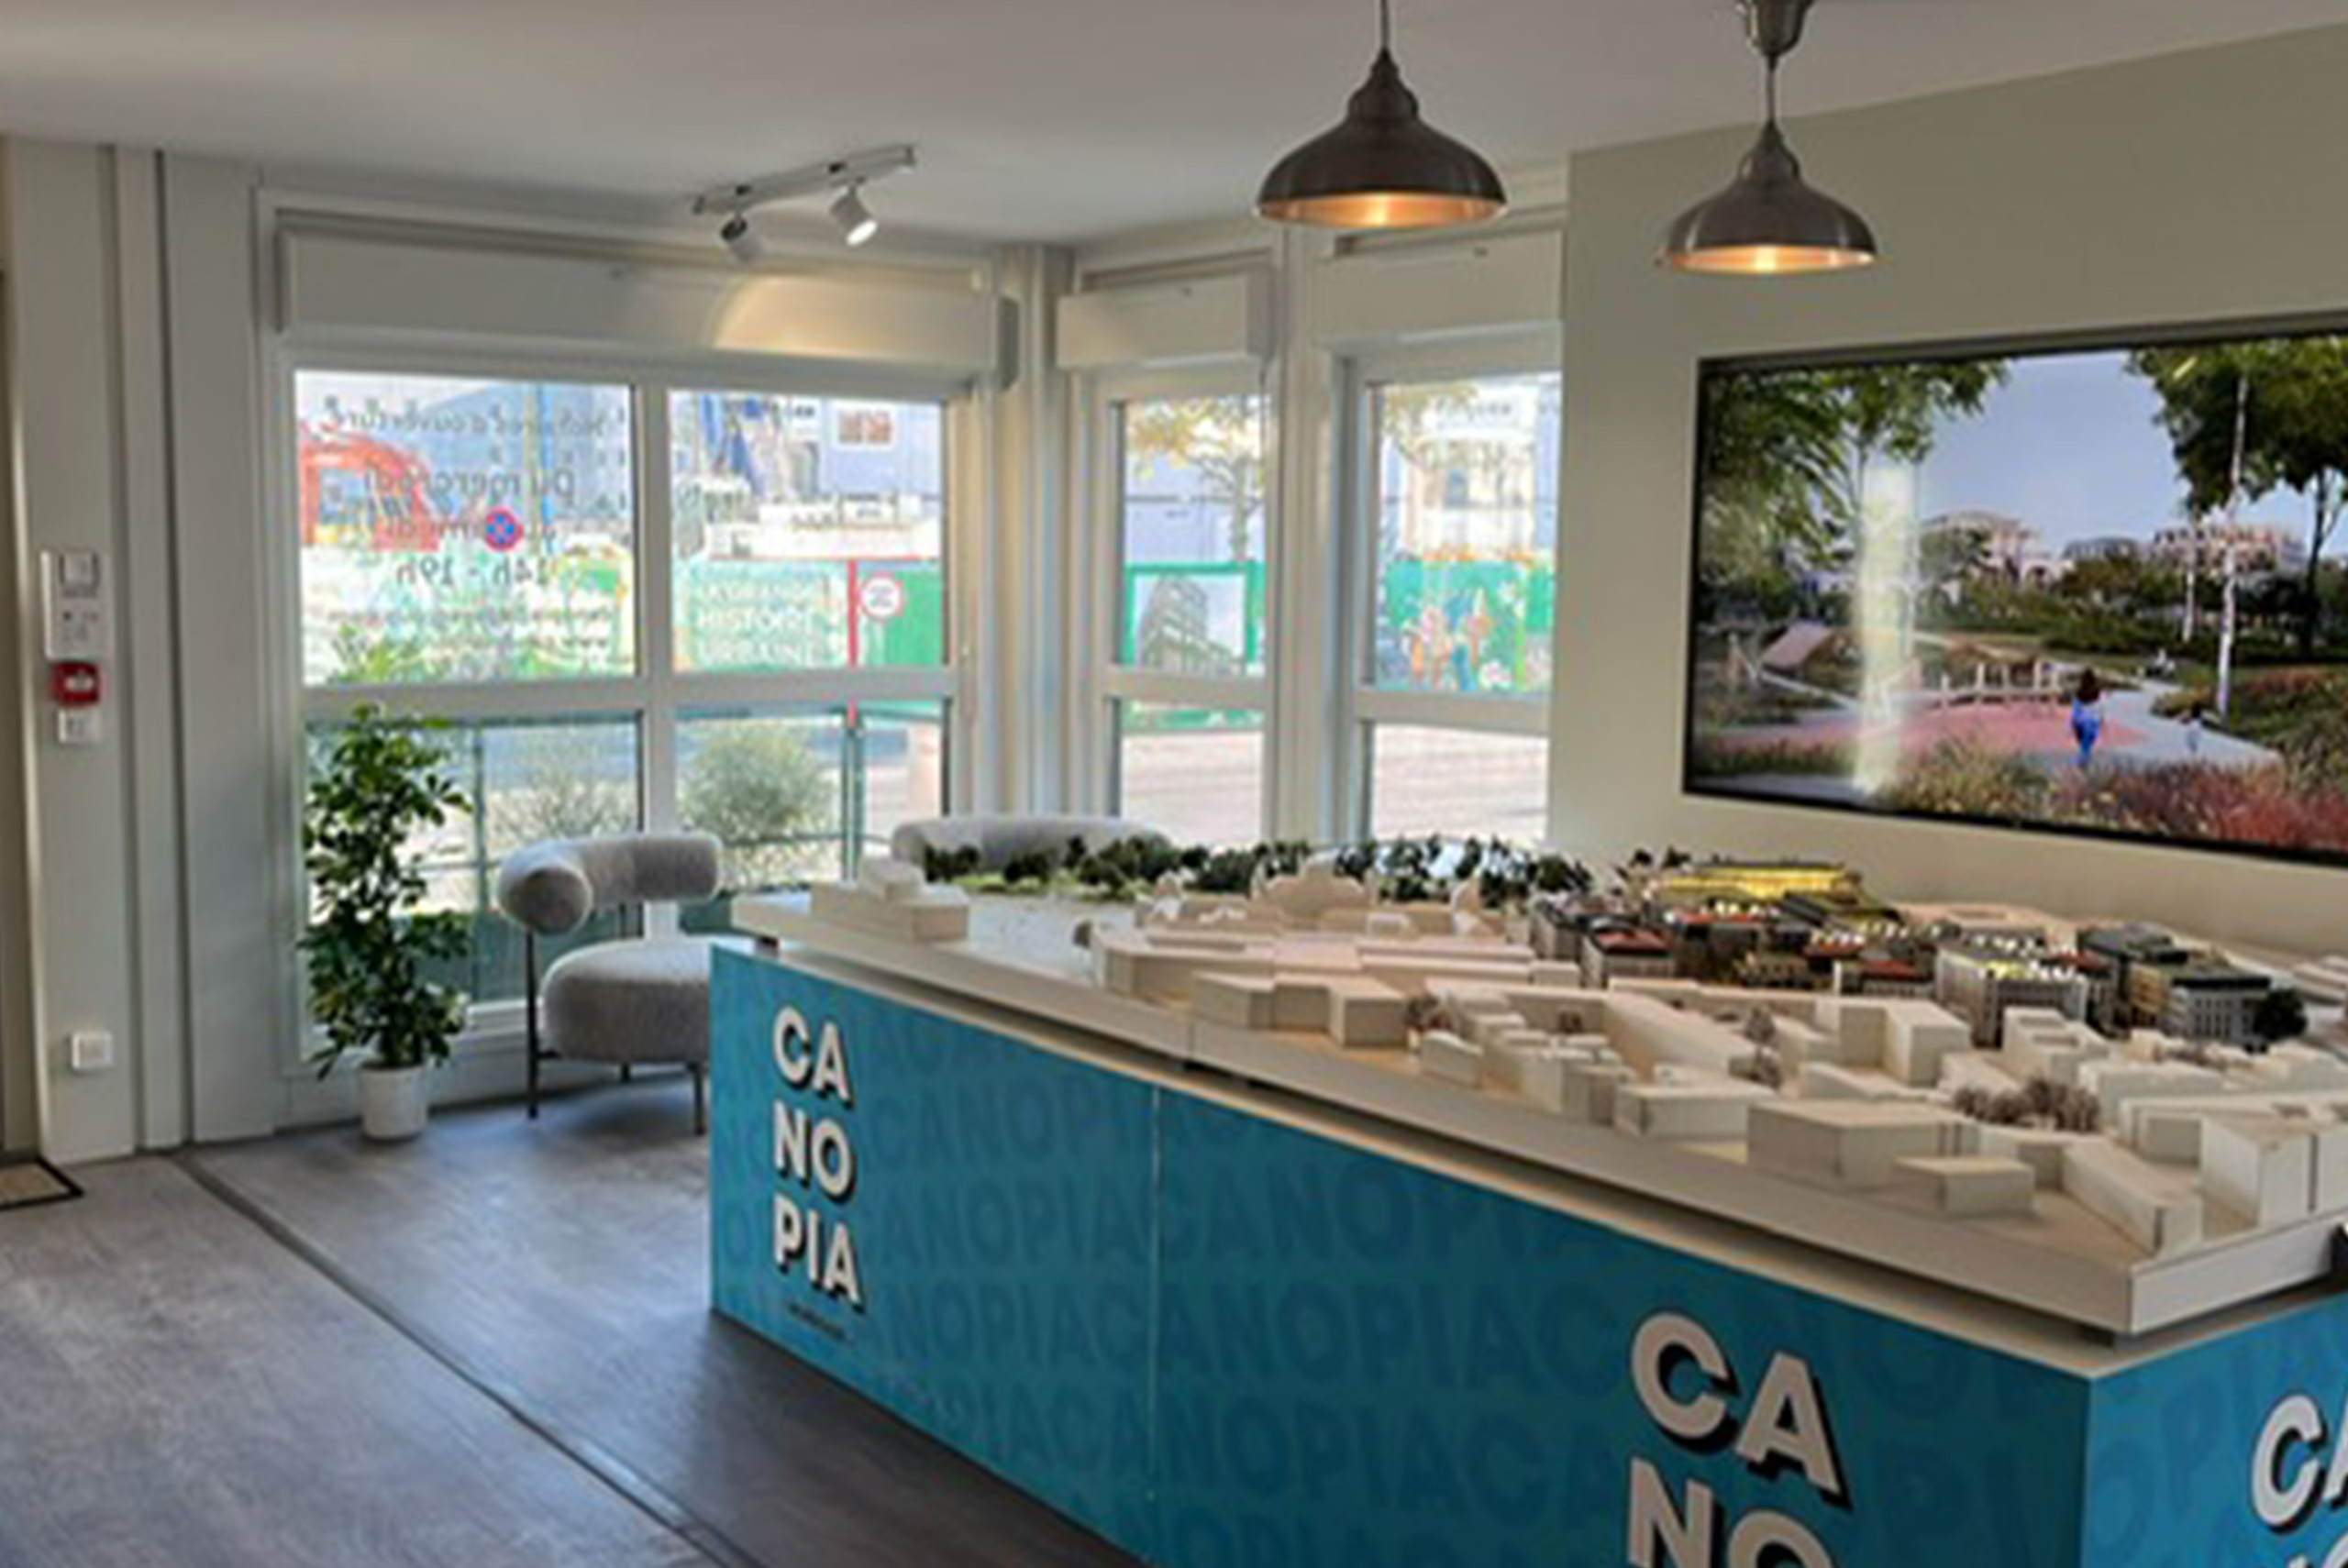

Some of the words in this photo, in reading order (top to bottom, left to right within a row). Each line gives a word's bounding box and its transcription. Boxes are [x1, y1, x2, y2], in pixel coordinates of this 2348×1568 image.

[772, 1006, 853, 1106] CA
[773, 1099, 855, 1200] NO
[773, 1193, 863, 1311] PIA
[1631, 1311, 1851, 1508] CA
